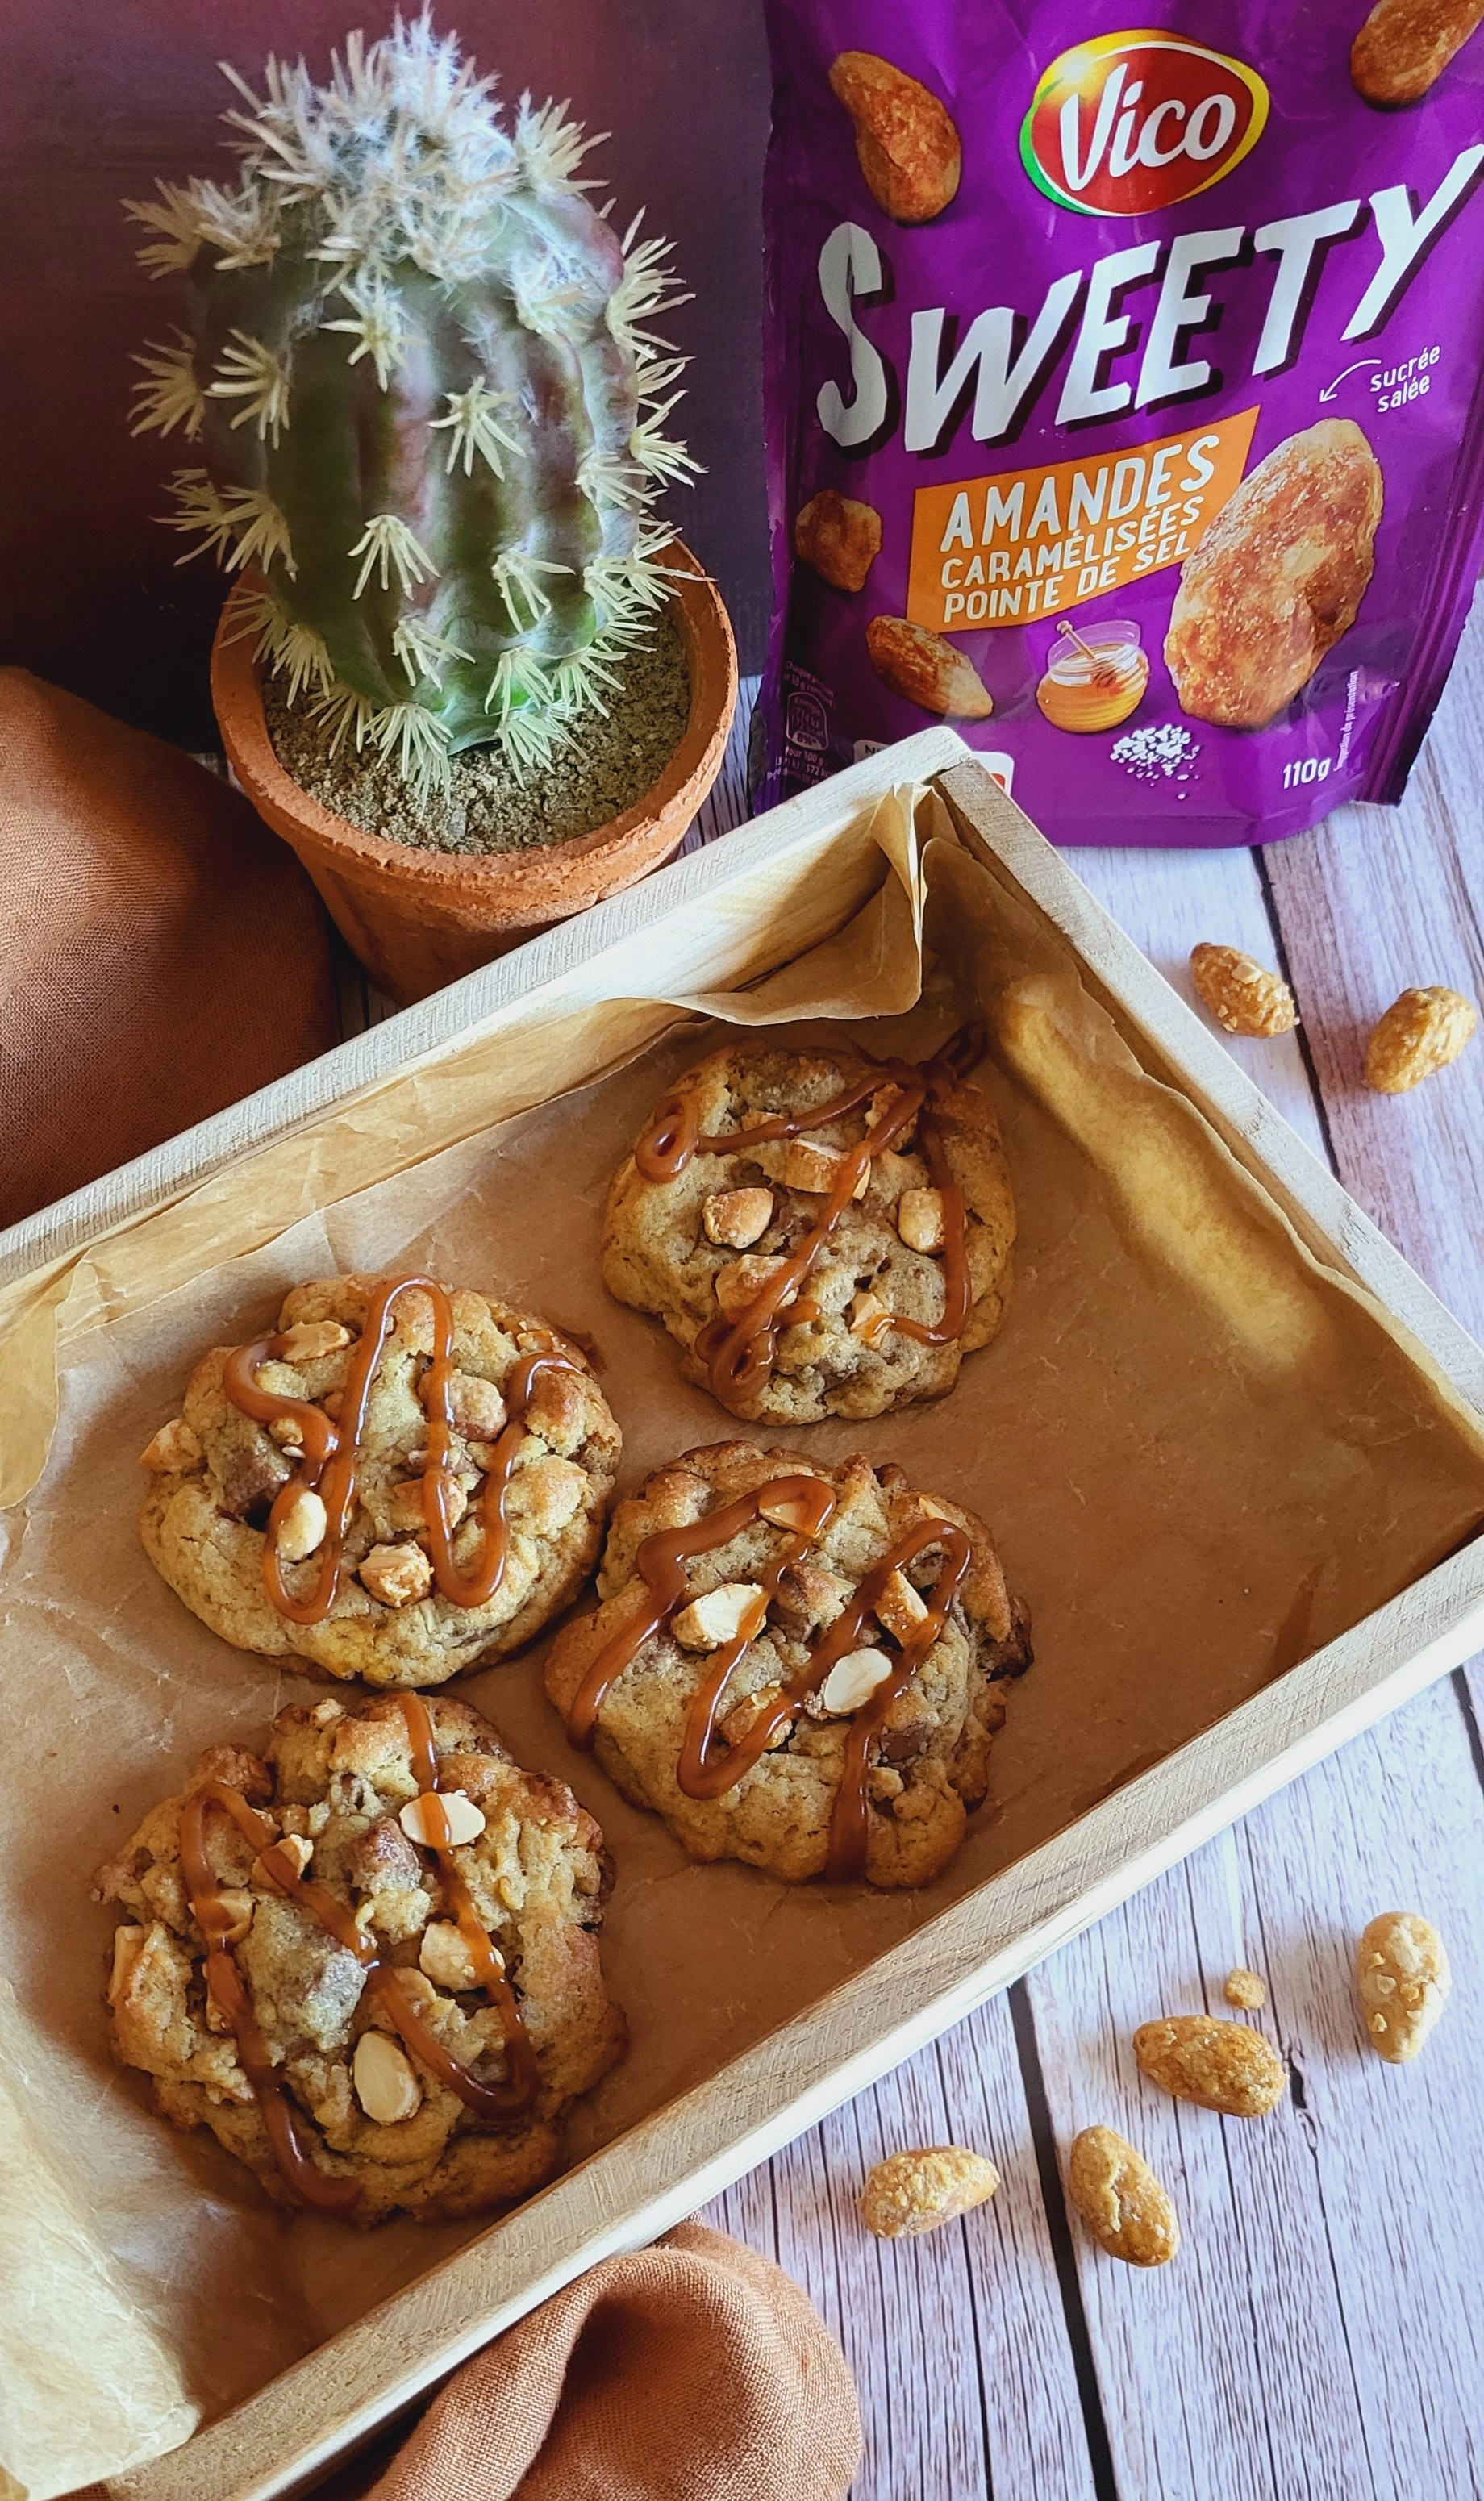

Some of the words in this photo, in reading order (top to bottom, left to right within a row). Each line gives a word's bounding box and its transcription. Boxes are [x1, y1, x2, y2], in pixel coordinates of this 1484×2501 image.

[1060, 63, 1236, 192] Vico
[816, 143, 1484, 452] SWEETY
[1370, 345, 1440, 392] sucrée
[1377, 376, 1430, 412] salée
[940, 435, 1219, 552] AMANDES
[941, 495, 1204, 589] CARAMÉLISÉES
[944, 575, 1064, 623] POINTE
[1076, 556, 1120, 598] DE
[1132, 531, 1190, 573] SEL
